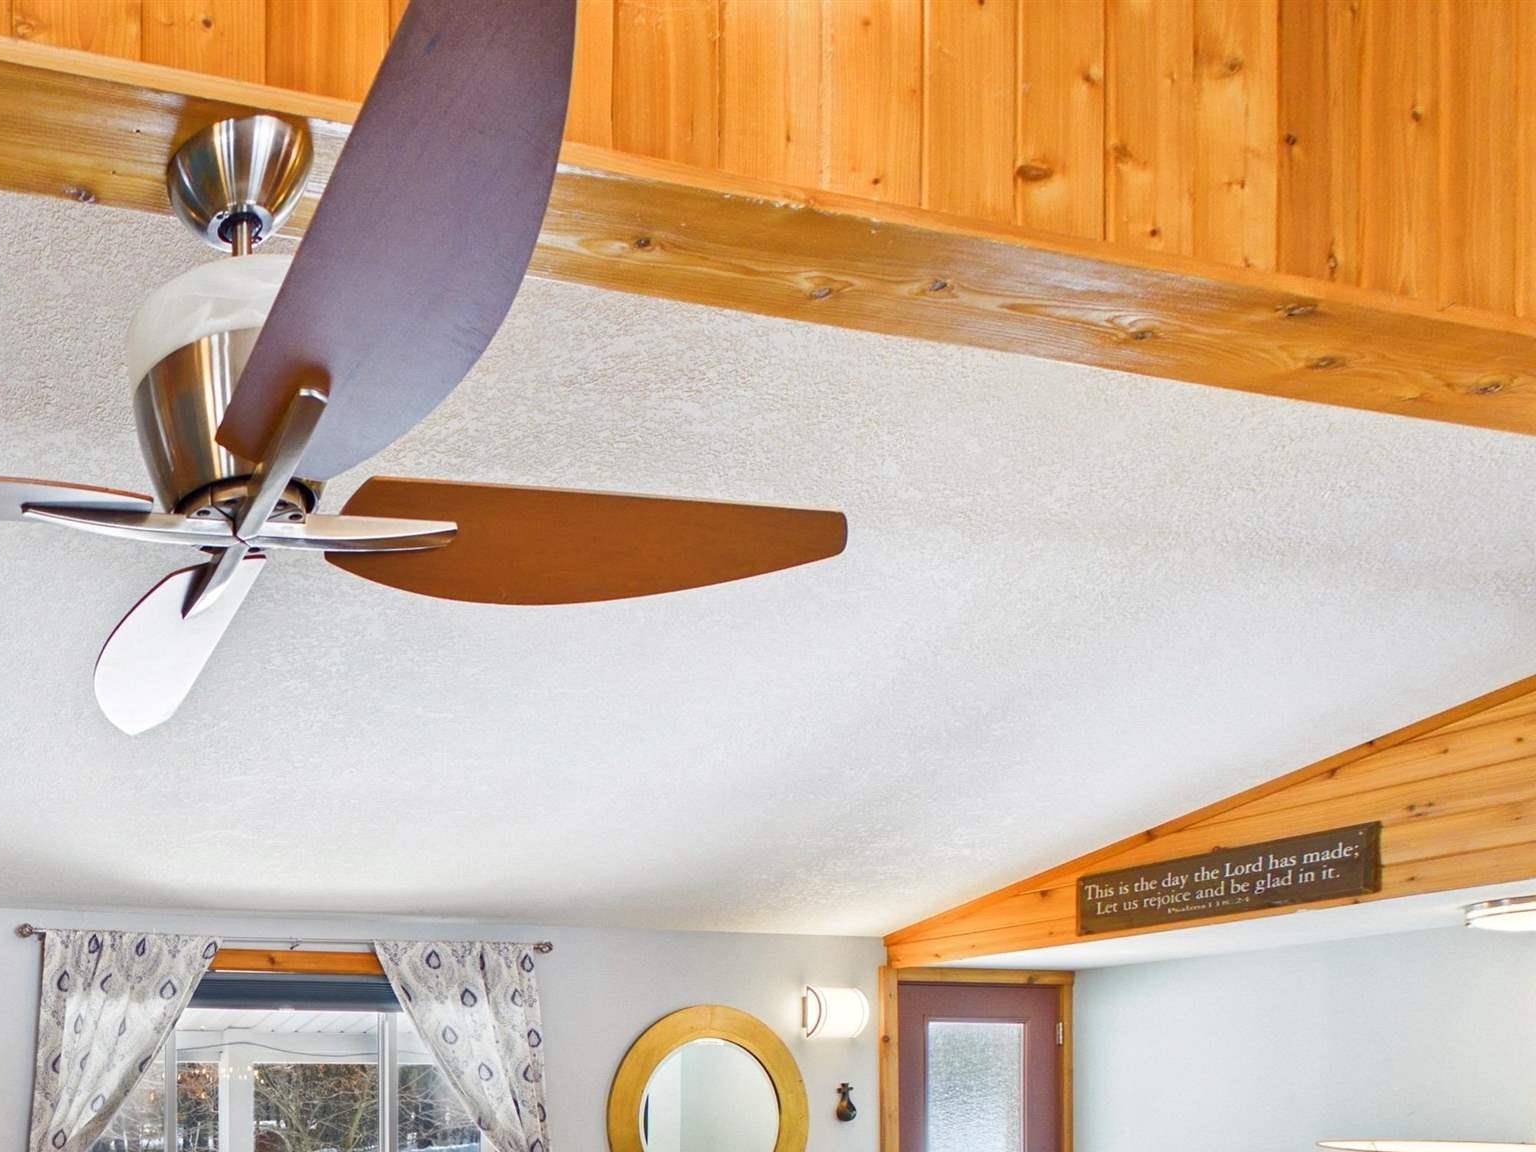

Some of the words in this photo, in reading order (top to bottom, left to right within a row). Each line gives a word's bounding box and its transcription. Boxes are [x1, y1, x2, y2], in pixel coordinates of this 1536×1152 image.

[1084, 884, 1115, 901] This
[1119, 881, 1129, 894] is
[1134, 877, 1157, 892] the
[1161, 872, 1189, 889] day
[1194, 866, 1220, 882] the
[1224, 856, 1263, 878] Lord
[1268, 854, 1297, 870] has
[1302, 842, 1360, 865] made;
[1096, 901, 1118, 916] Let
[1123, 899, 1138, 911] us
[1143, 889, 1192, 910] rejoice
[1195, 881, 1225, 900] and
[1229, 879, 1250, 895] be
[1254, 870, 1292, 895] glad
[1298, 868, 1314, 884] in
[1321, 864, 1341, 880] it.
